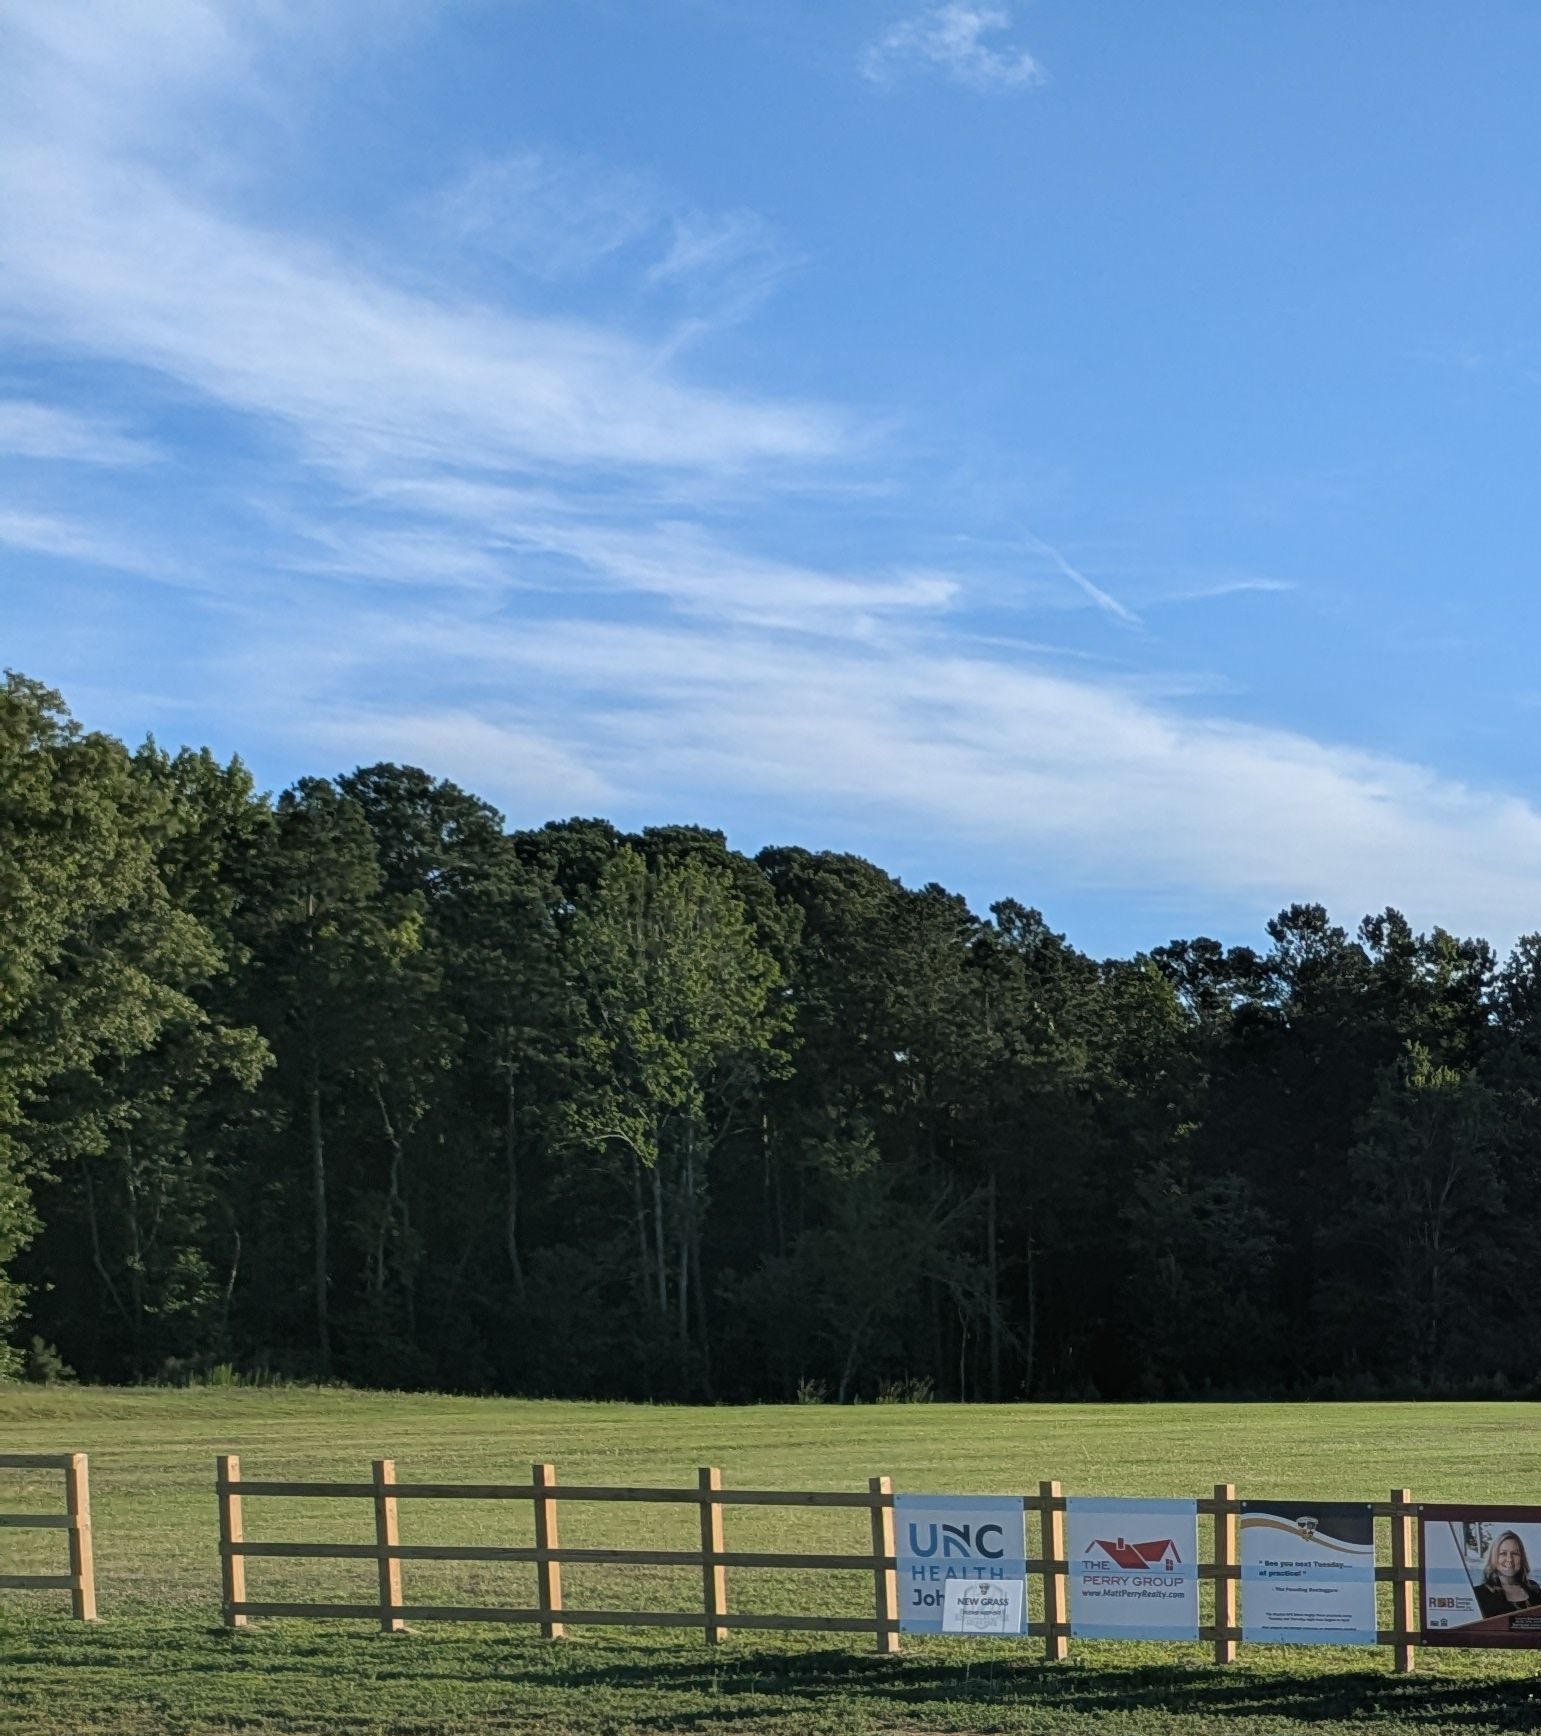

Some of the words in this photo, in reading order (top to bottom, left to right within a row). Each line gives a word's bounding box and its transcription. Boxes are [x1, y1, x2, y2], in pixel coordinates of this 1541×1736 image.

[908, 1523, 1004, 1559] UNC
[1081, 1560, 1110, 1570] THE
[1083, 1576, 1130, 1586] PERRY
[1132, 1577, 1184, 1587] GROUP
[957, 1597, 978, 1606] NEW
